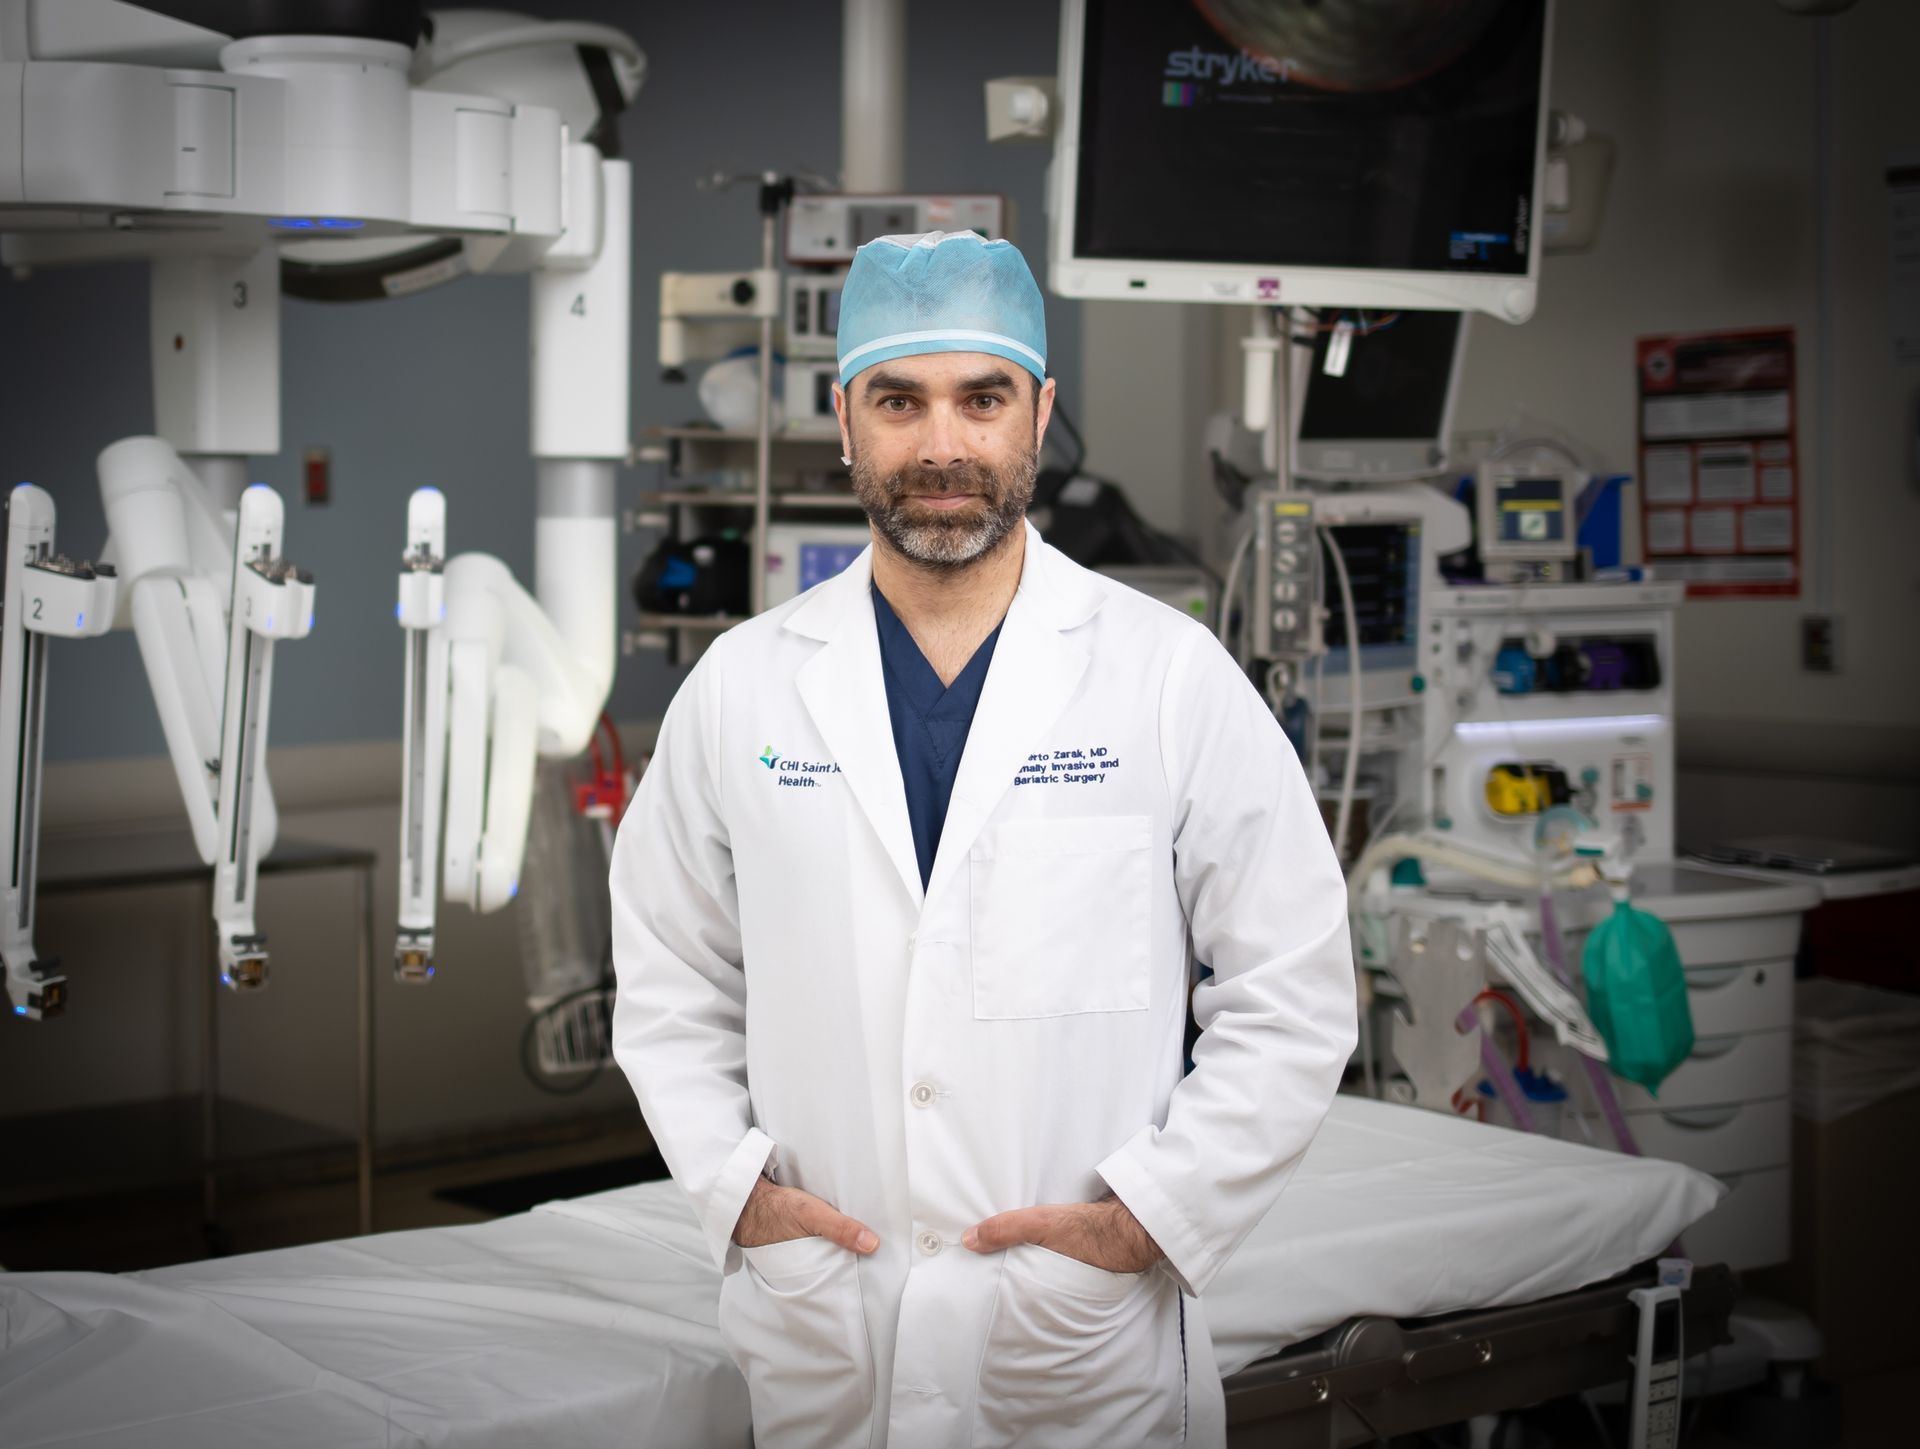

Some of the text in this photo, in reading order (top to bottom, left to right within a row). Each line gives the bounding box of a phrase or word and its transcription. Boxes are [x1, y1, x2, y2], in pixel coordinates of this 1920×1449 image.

[1165, 46, 1297, 85] stryker
[233, 281, 248, 309] 3
[570, 294, 585, 316] 4
[32, 597, 43, 620] 2
[1090, 747, 1107, 757] MD
[780, 760, 800, 772] CHI
[801, 762, 831, 773] Saint
[1051, 761, 1095, 771] Invasive
[1100, 758, 1119, 769] and
[778, 775, 815, 788] Health
[1014, 773, 1105, 786] Bariatric Surgery
